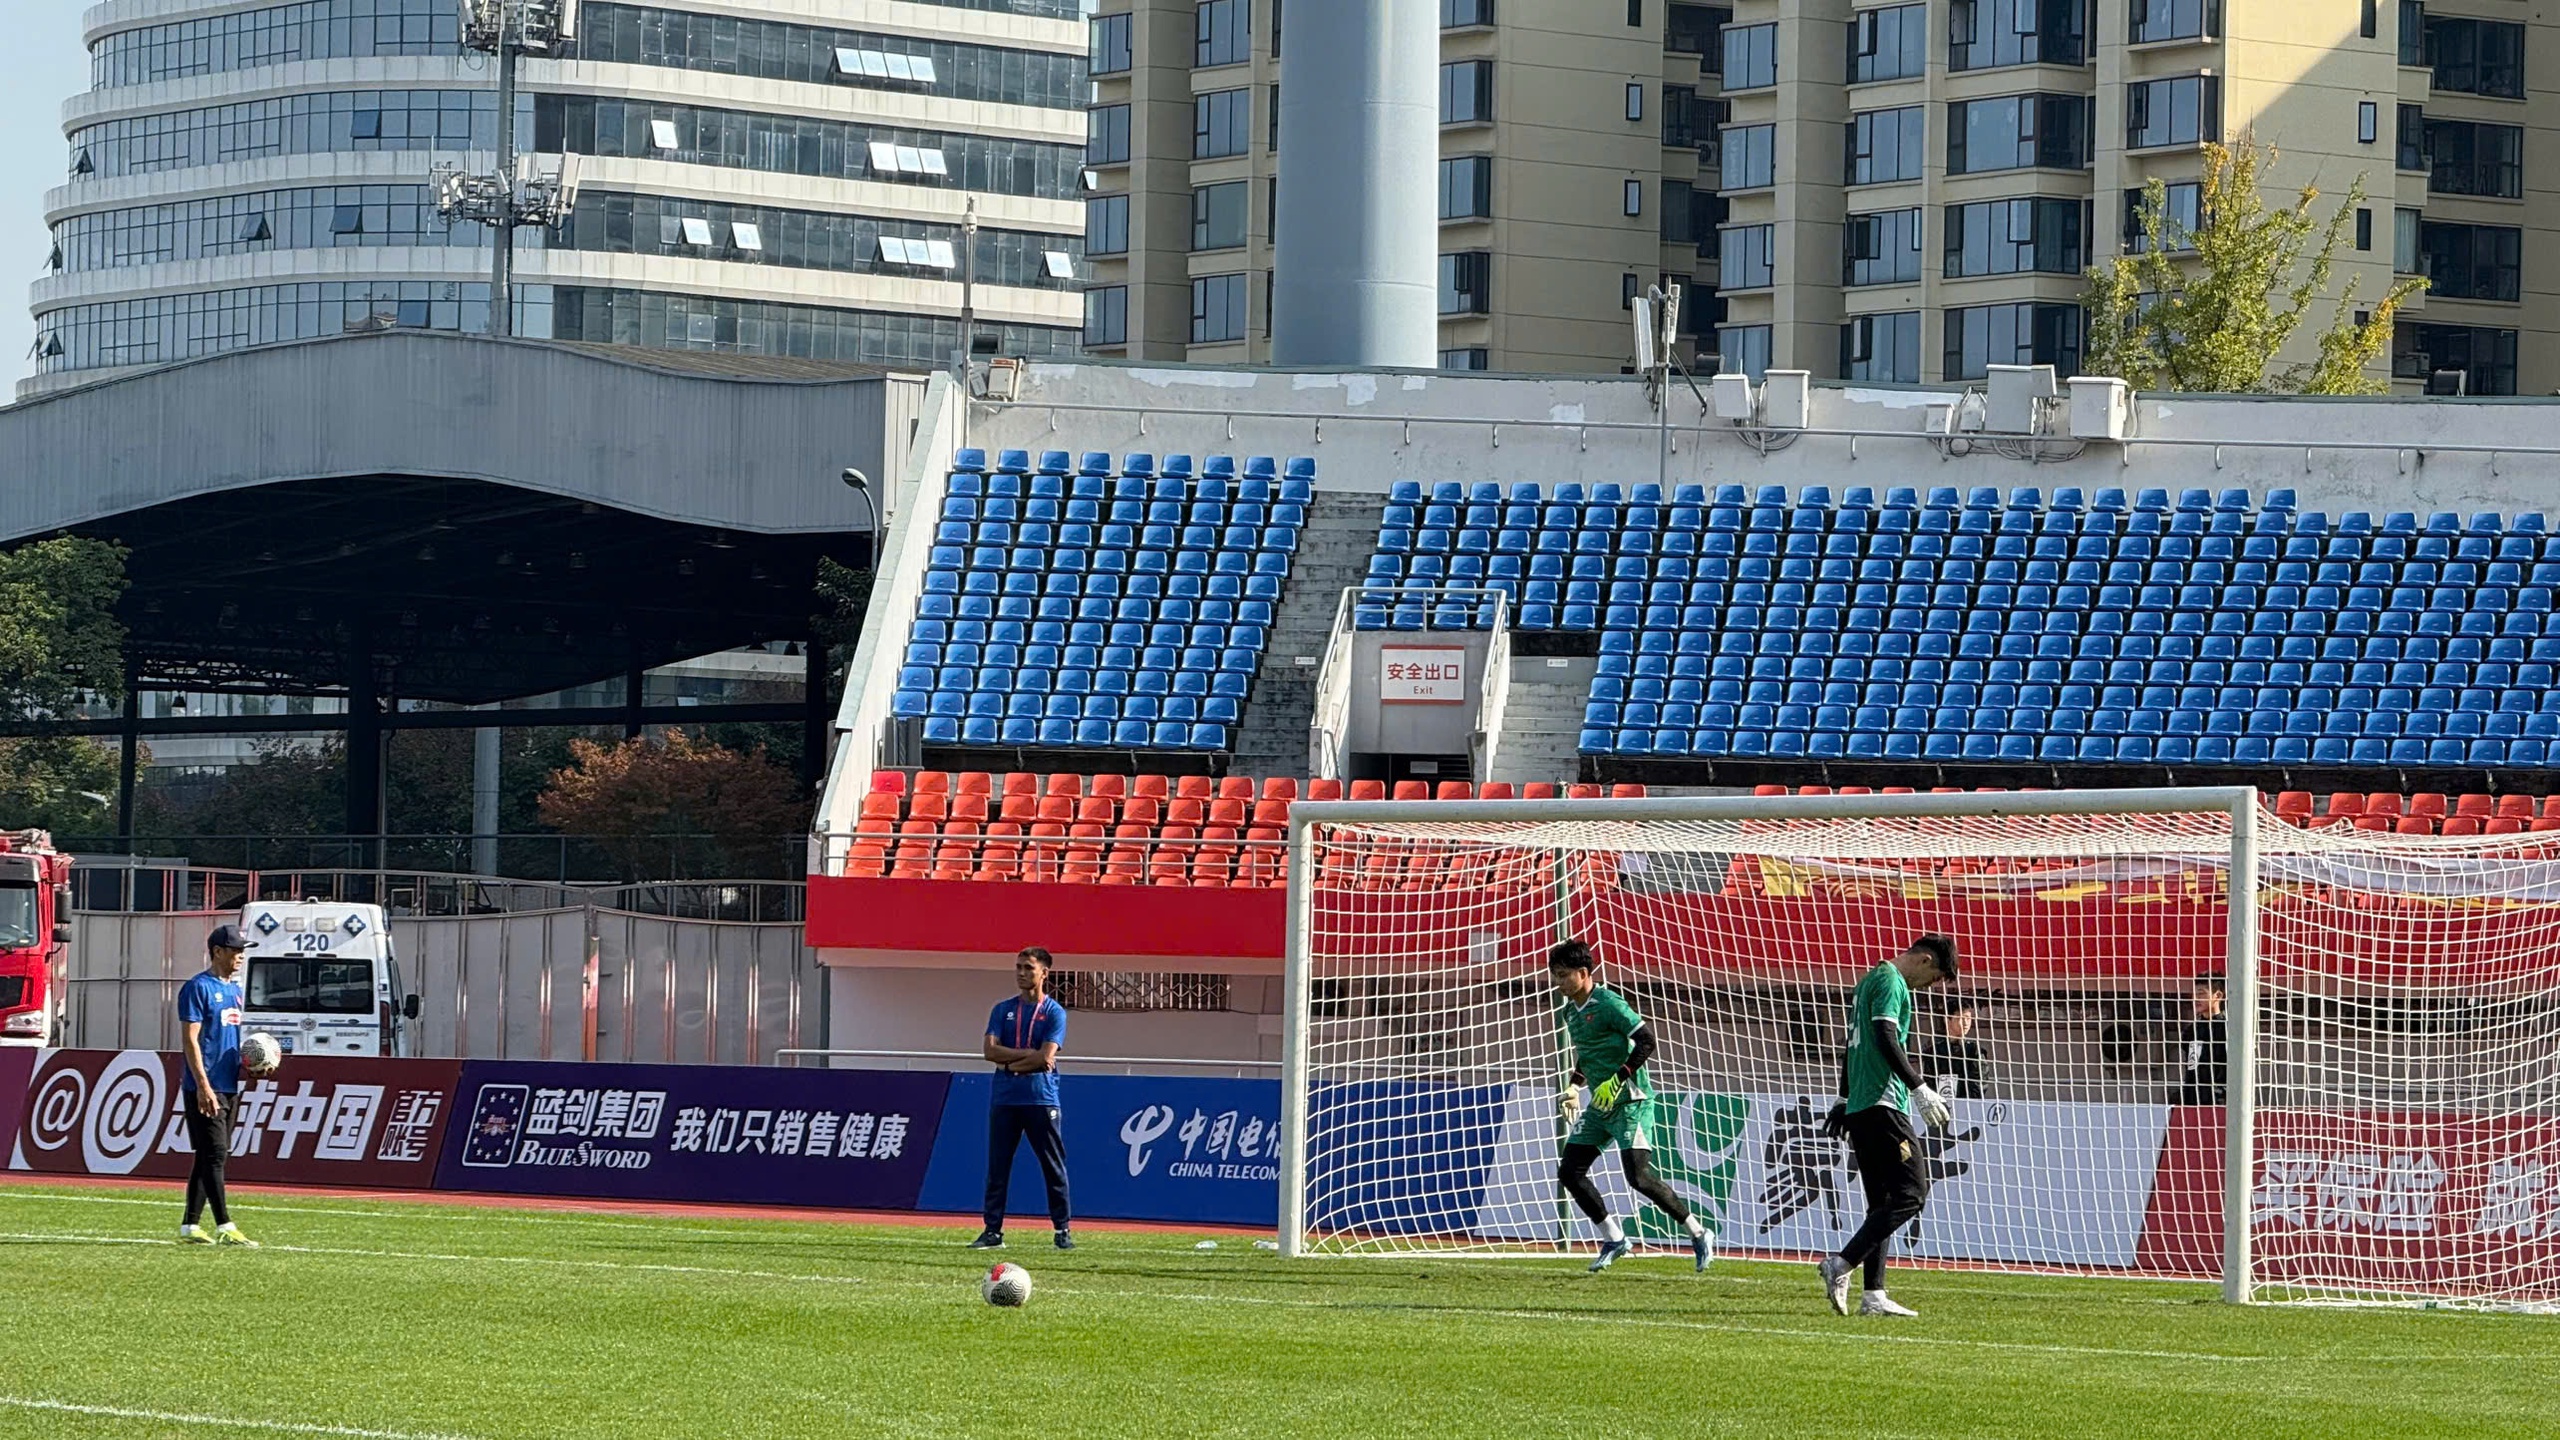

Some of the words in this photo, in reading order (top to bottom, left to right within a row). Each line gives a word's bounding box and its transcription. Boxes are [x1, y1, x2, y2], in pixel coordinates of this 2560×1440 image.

[1387, 662, 1459, 680] 安全出口
[1413, 685, 1433, 695] Exit
[293, 933, 329, 952] 120
[524, 1087, 667, 1139] 蓝剑集团
[670, 1107, 909, 1161] 我们只销售健康
[1169, 1161, 1213, 1178] CHINA
